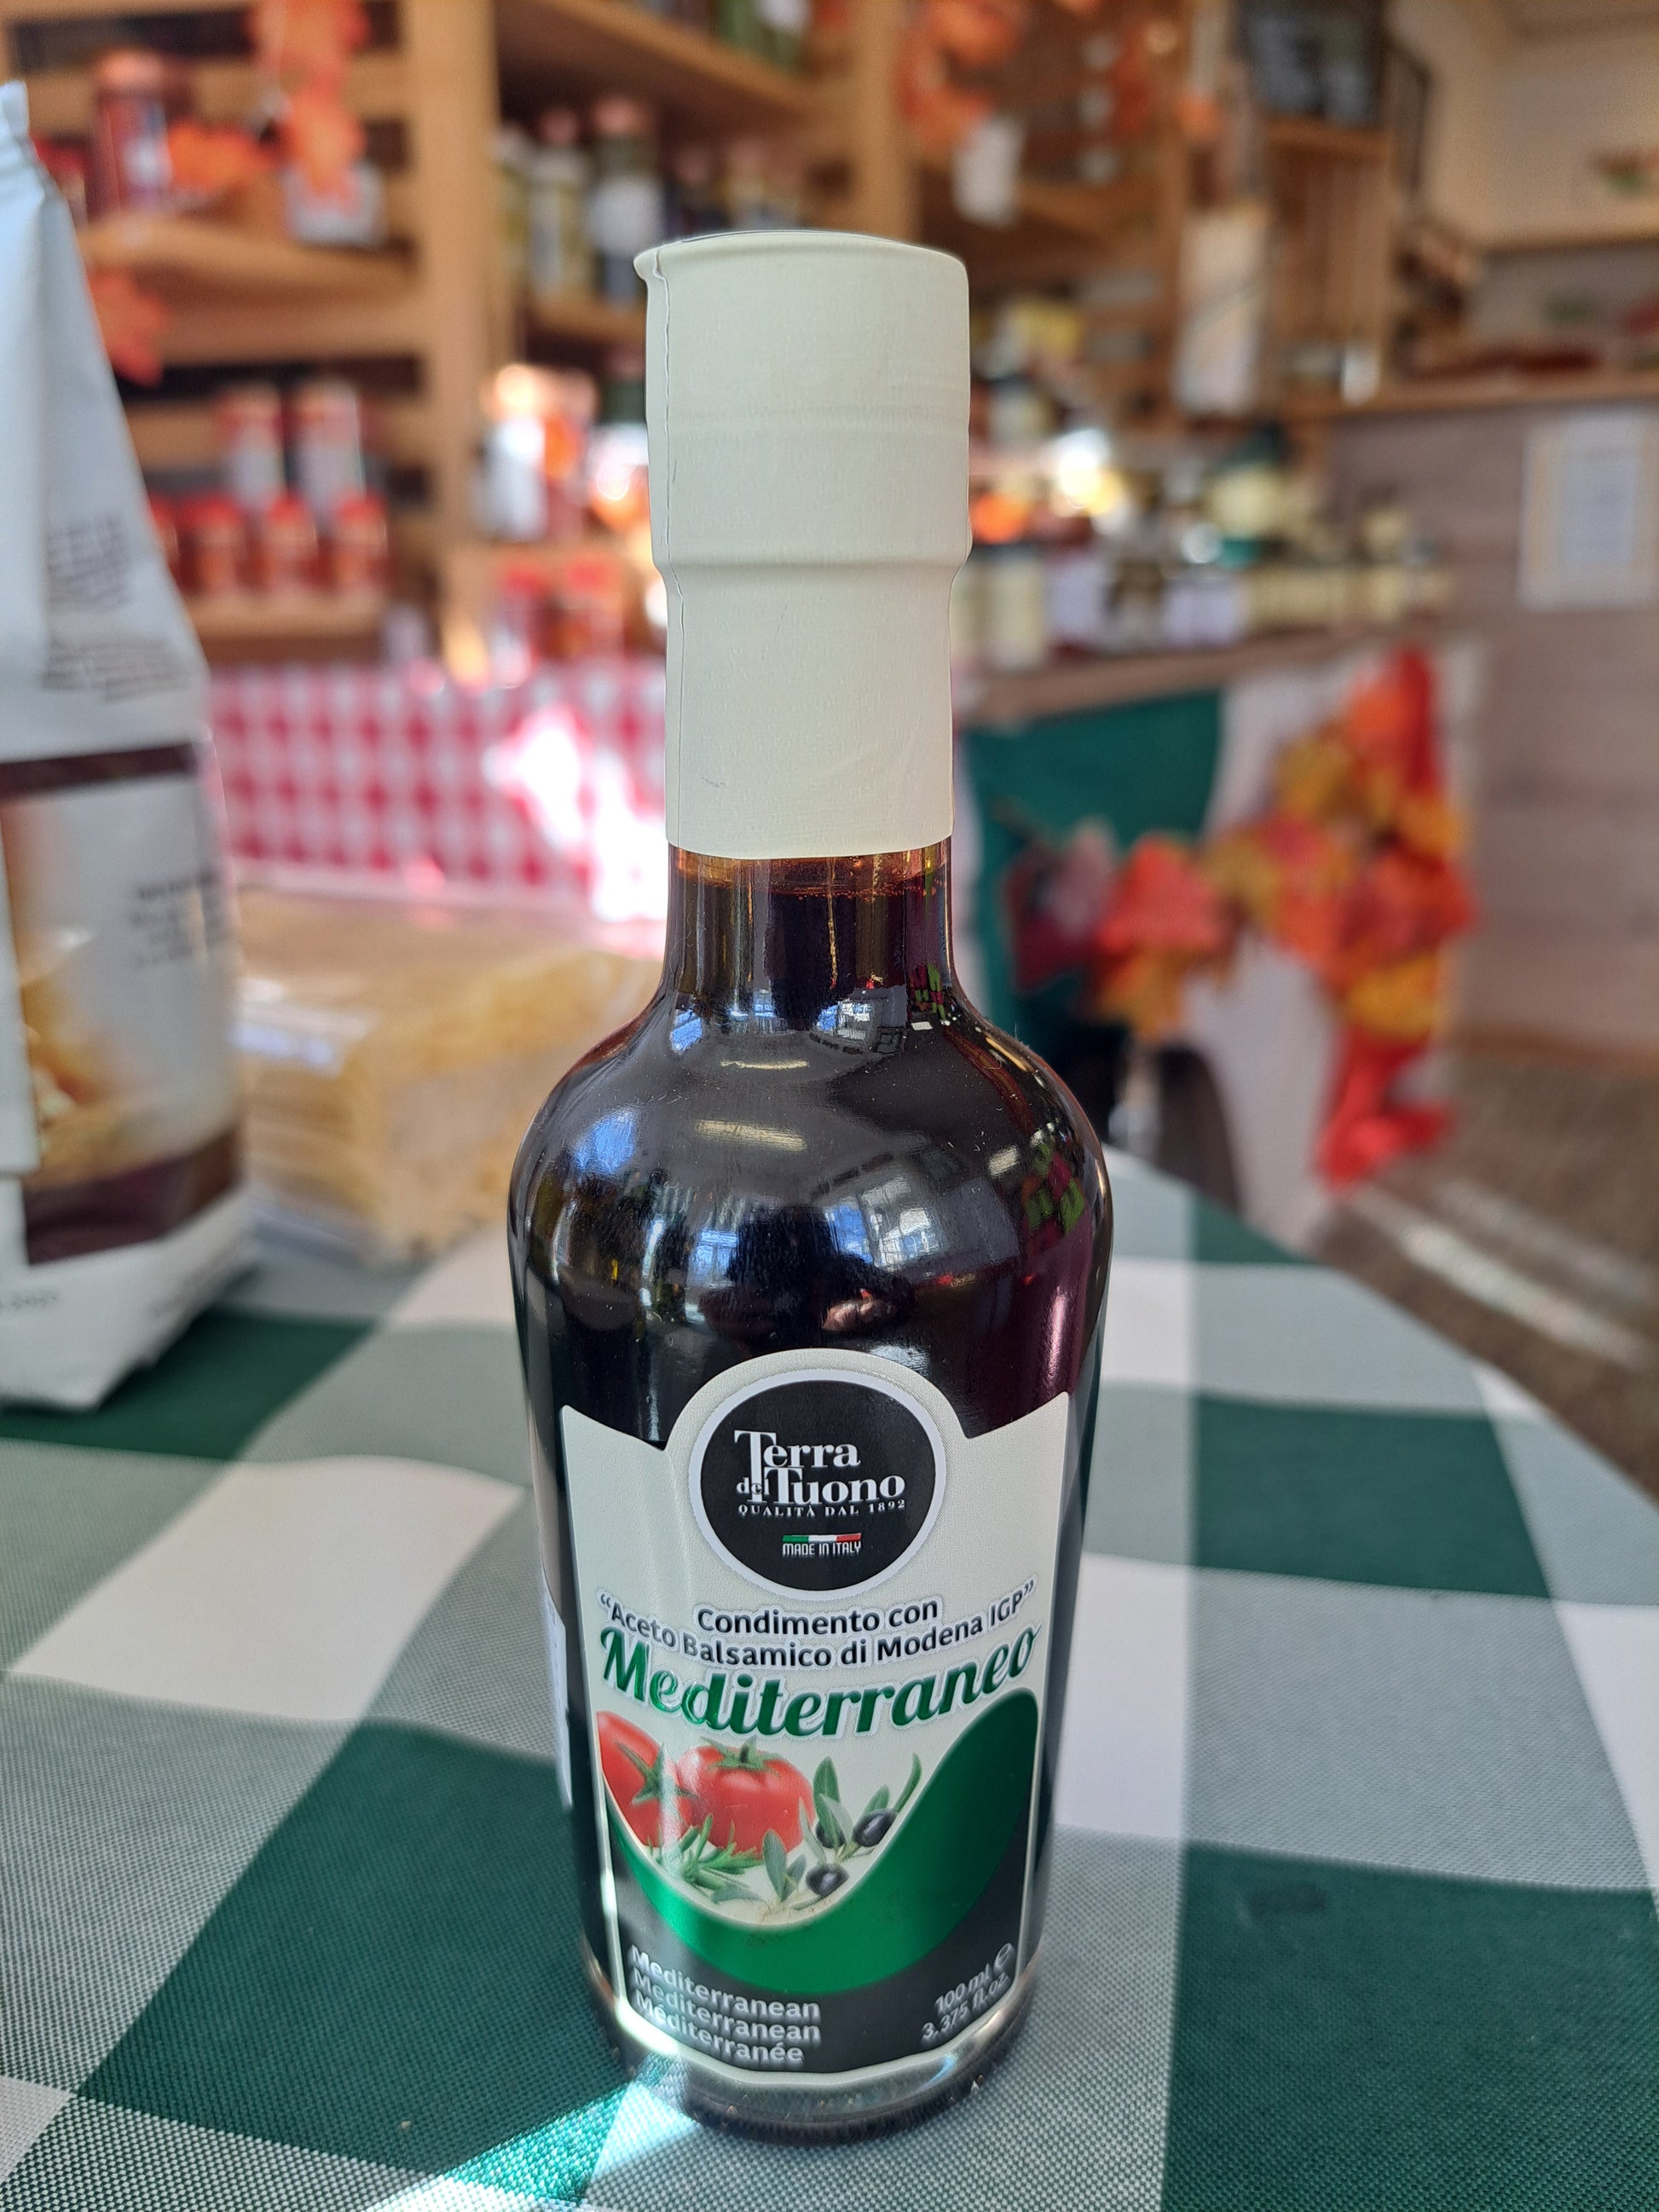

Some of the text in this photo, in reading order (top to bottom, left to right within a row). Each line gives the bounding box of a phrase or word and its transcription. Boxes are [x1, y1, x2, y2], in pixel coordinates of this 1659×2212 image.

[734, 1429, 861, 1504] Terra
[737, 1466, 905, 1505] del Tuono
[738, 1499, 905, 1516] QUALITÀ DAL 1892
[782, 1541, 862, 1556] MADE IN ITALY
[684, 1632, 832, 1666] Balsamico
[841, 1637, 867, 1665] di
[877, 1615, 984, 1661] Modena
[697, 1599, 938, 1635] Condimento con
[600, 1623, 1043, 1736] Mediterraneo
[629, 1943, 821, 2018] Mediterranean
[633, 1967, 821, 2041] Mediterranean
[934, 1983, 967, 2013] 100
[968, 1962, 991, 1995] ml
[634, 1988, 804, 2062] Méditerranée
[922, 2000, 968, 2038] 3.375
